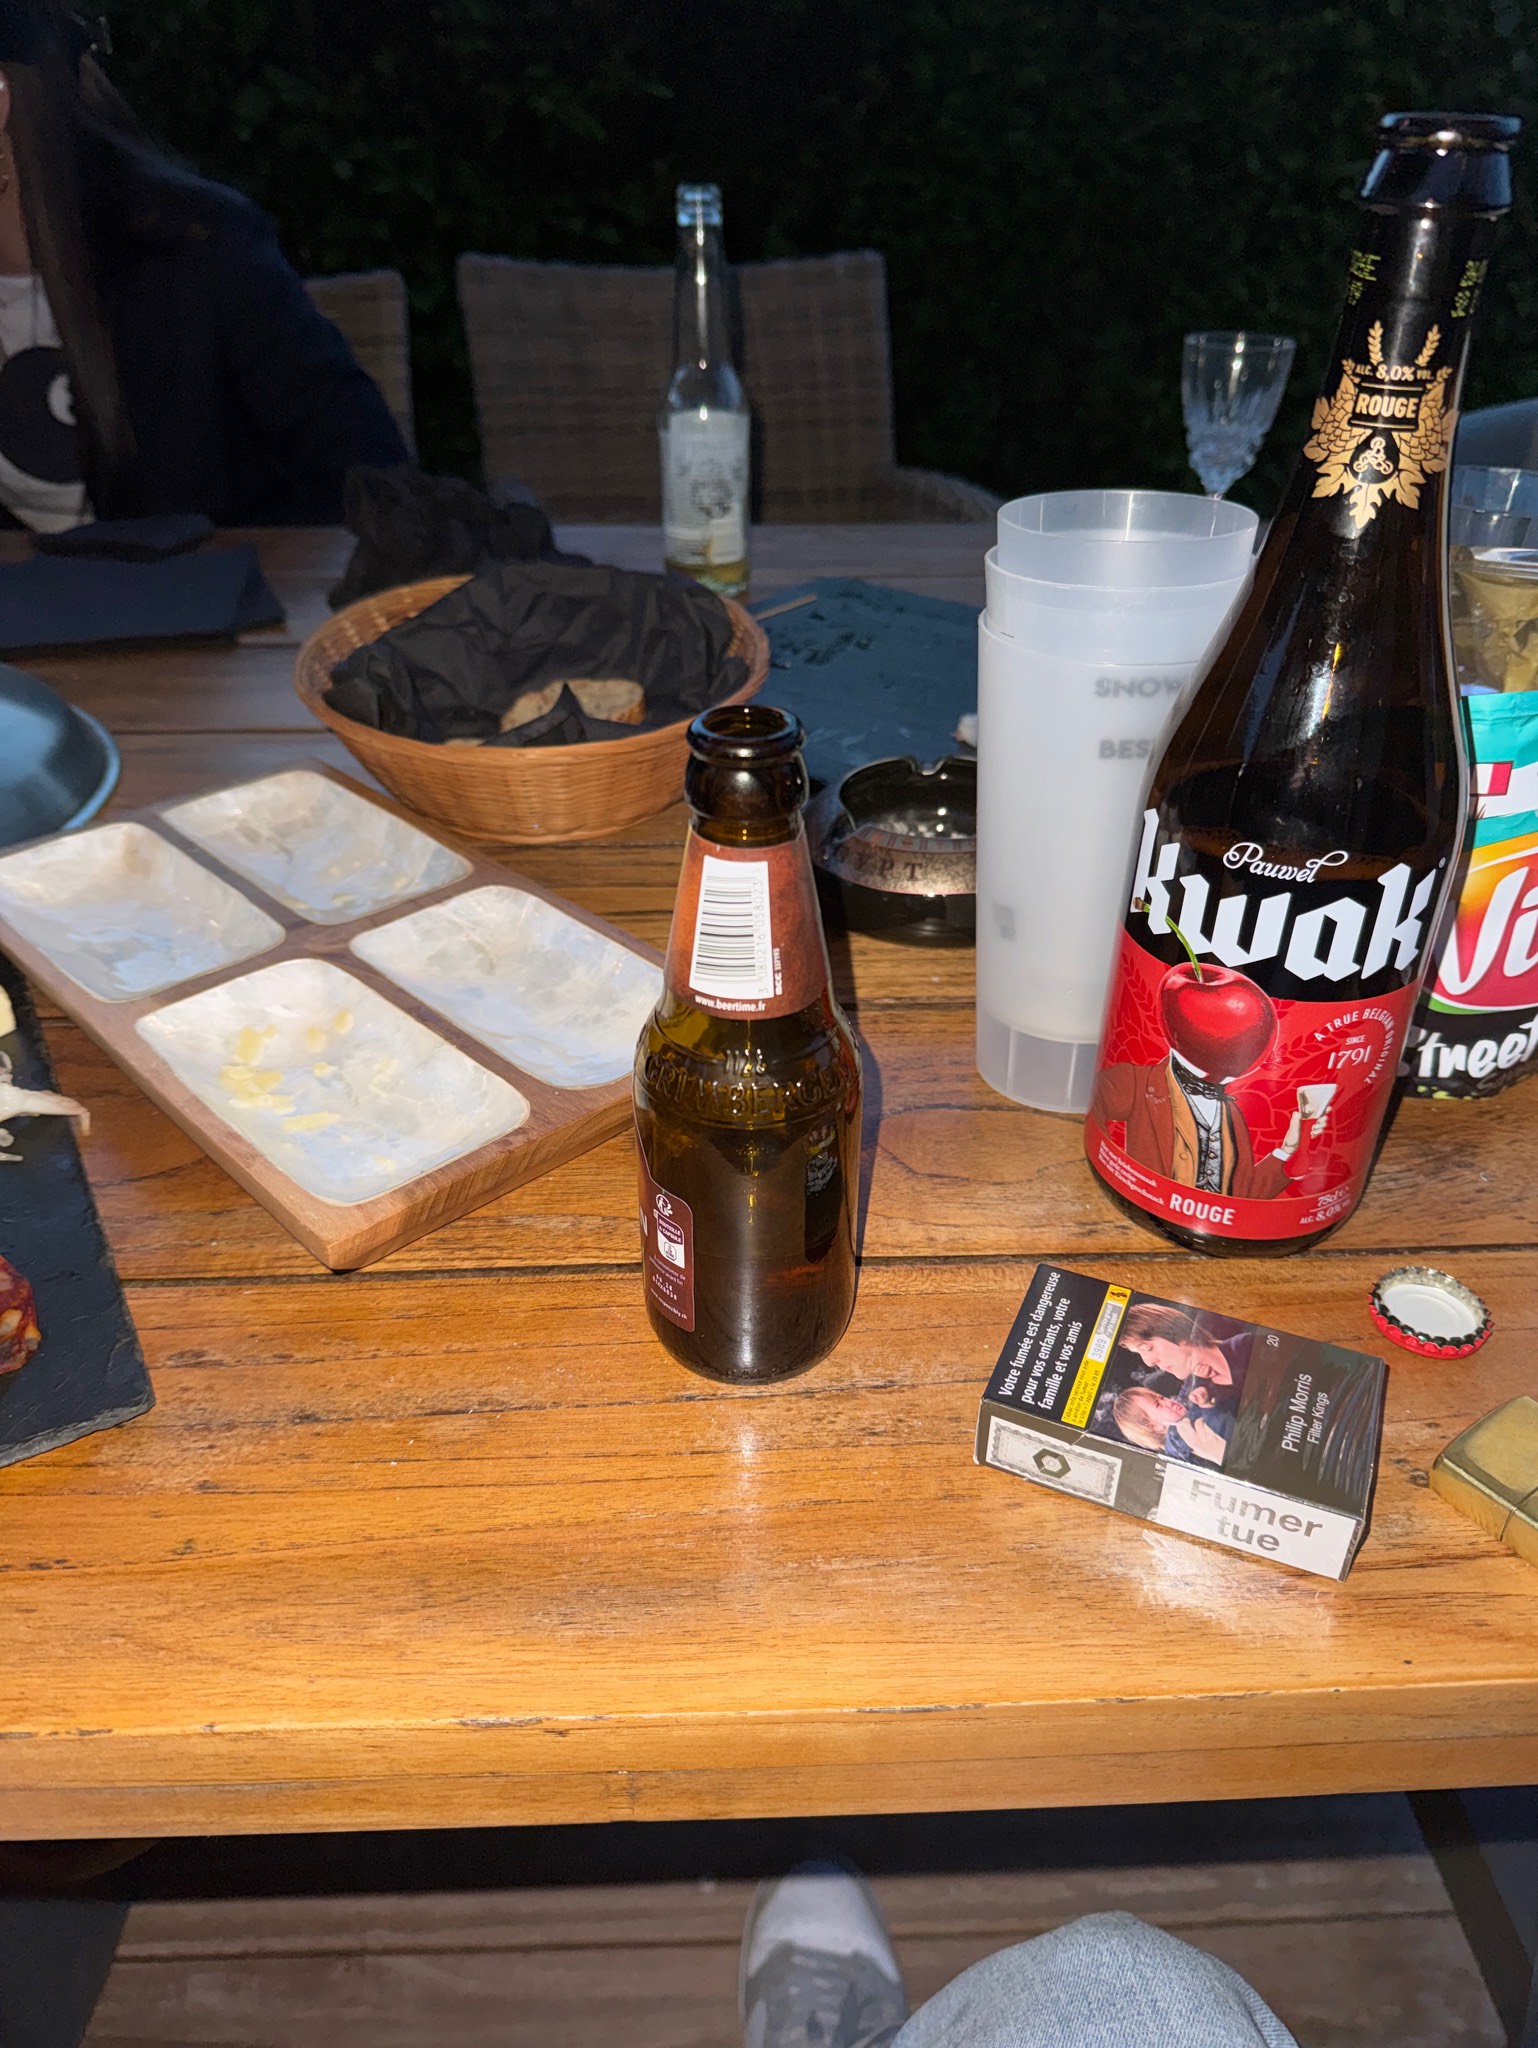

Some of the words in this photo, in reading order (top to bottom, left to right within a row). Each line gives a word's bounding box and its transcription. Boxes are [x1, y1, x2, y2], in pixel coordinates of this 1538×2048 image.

[1355, 364, 1373, 376] ALC.
[1376, 364, 1415, 382] 8,0%
[1416, 369, 1434, 379] VOL.
[1355, 393, 1419, 418] ROUGE
[1098, 738, 1156, 760] BES
[1223, 842, 1348, 884] Pauwel
[1130, 808, 1436, 982] kwak
[694, 994, 766, 1012] www.beertime.fr
[1325, 1011, 1359, 1032] TRUE
[1362, 1007, 1394, 1031] BELGIAN
[1314, 1032, 1326, 1041] A
[1345, 1035, 1366, 1045] SINCE
[1327, 1045, 1371, 1069] 1791
[1363, 1030, 1394, 1084] ORIGINAL
[1169, 1193, 1236, 1226] ROUGE
[1030, 1272, 1061, 1322] dangereuse
[1026, 1321, 1040, 1337] est
[1066, 1320, 1083, 1344] amis
[1266, 1335, 1279, 1347] 20
[1010, 1337, 1033, 1368] fumée
[1021, 1378, 1039, 1405] pour
[1031, 1359, 1046, 1378] vos
[1039, 1323, 1063, 1360] enfants,
[1053, 1297, 1070, 1321] votre
[1059, 1343, 1074, 1361] vos
[1091, 1336, 1107, 1358] 3989
[1055, 1360, 1067, 1373] et
[998, 1368, 1021, 1396] Votre
[1038, 1373, 1063, 1410] famille
[1288, 1373, 1312, 1414] Morris
[1311, 1391, 1330, 1419] Kings
[1281, 1415, 1308, 1453] Philip
[1307, 1419, 1323, 1444] Filter
[1190, 1479, 1323, 1537] Fumer
[1216, 1516, 1280, 1551] tue
